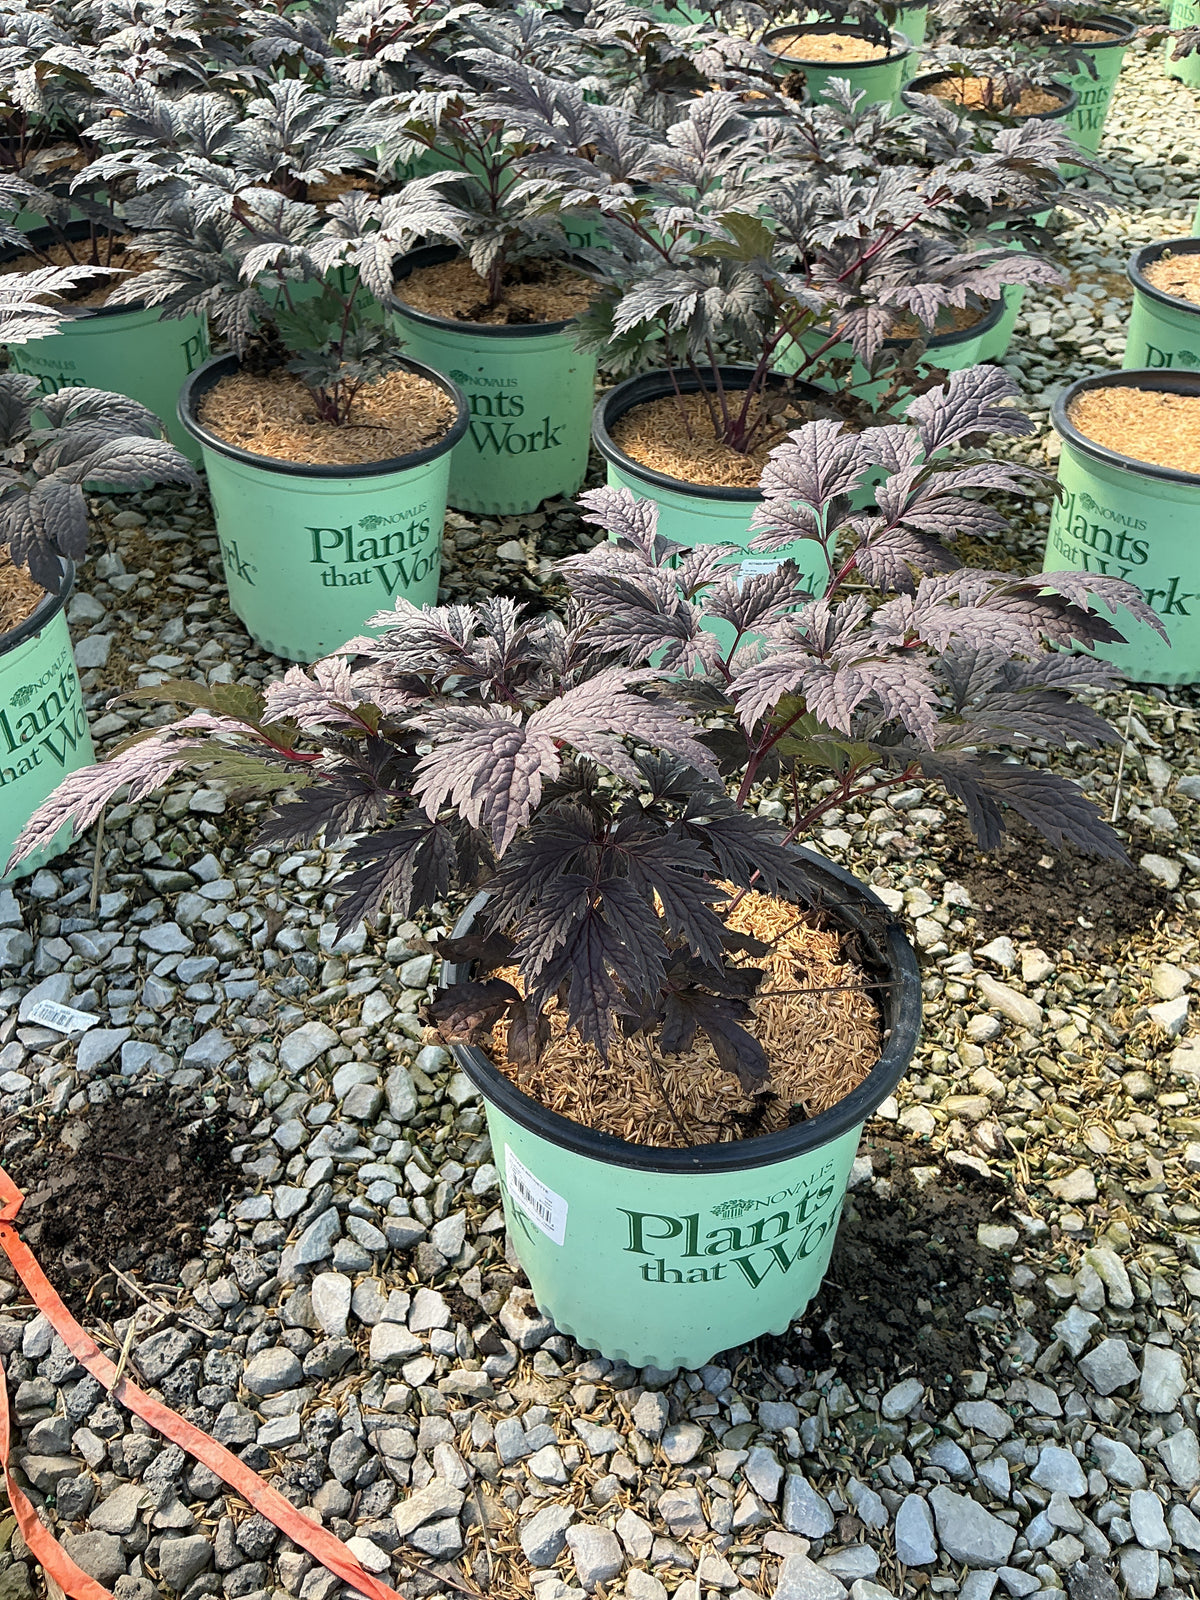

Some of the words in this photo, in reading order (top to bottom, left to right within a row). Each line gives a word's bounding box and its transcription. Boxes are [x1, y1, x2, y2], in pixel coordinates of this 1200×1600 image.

[470, 377, 518, 388] NOVALIS
[468, 391, 525, 418] nts
[469, 415, 563, 456] Work
[382, 501, 428, 526] NOVALIS
[1054, 488, 1150, 566] Plants
[1092, 505, 1148, 532] NOVALIS
[304, 517, 431, 564] Plants
[1052, 527, 1079, 566] that
[320, 565, 373, 587] that
[33, 646, 68, 695] NOVALIS
[0, 662, 77, 755] lants
[0, 747, 44, 788] hat
[754, 1158, 835, 1212] NOVALIS
[615, 1173, 837, 1258] Plants
[638, 1257, 728, 1285] that
